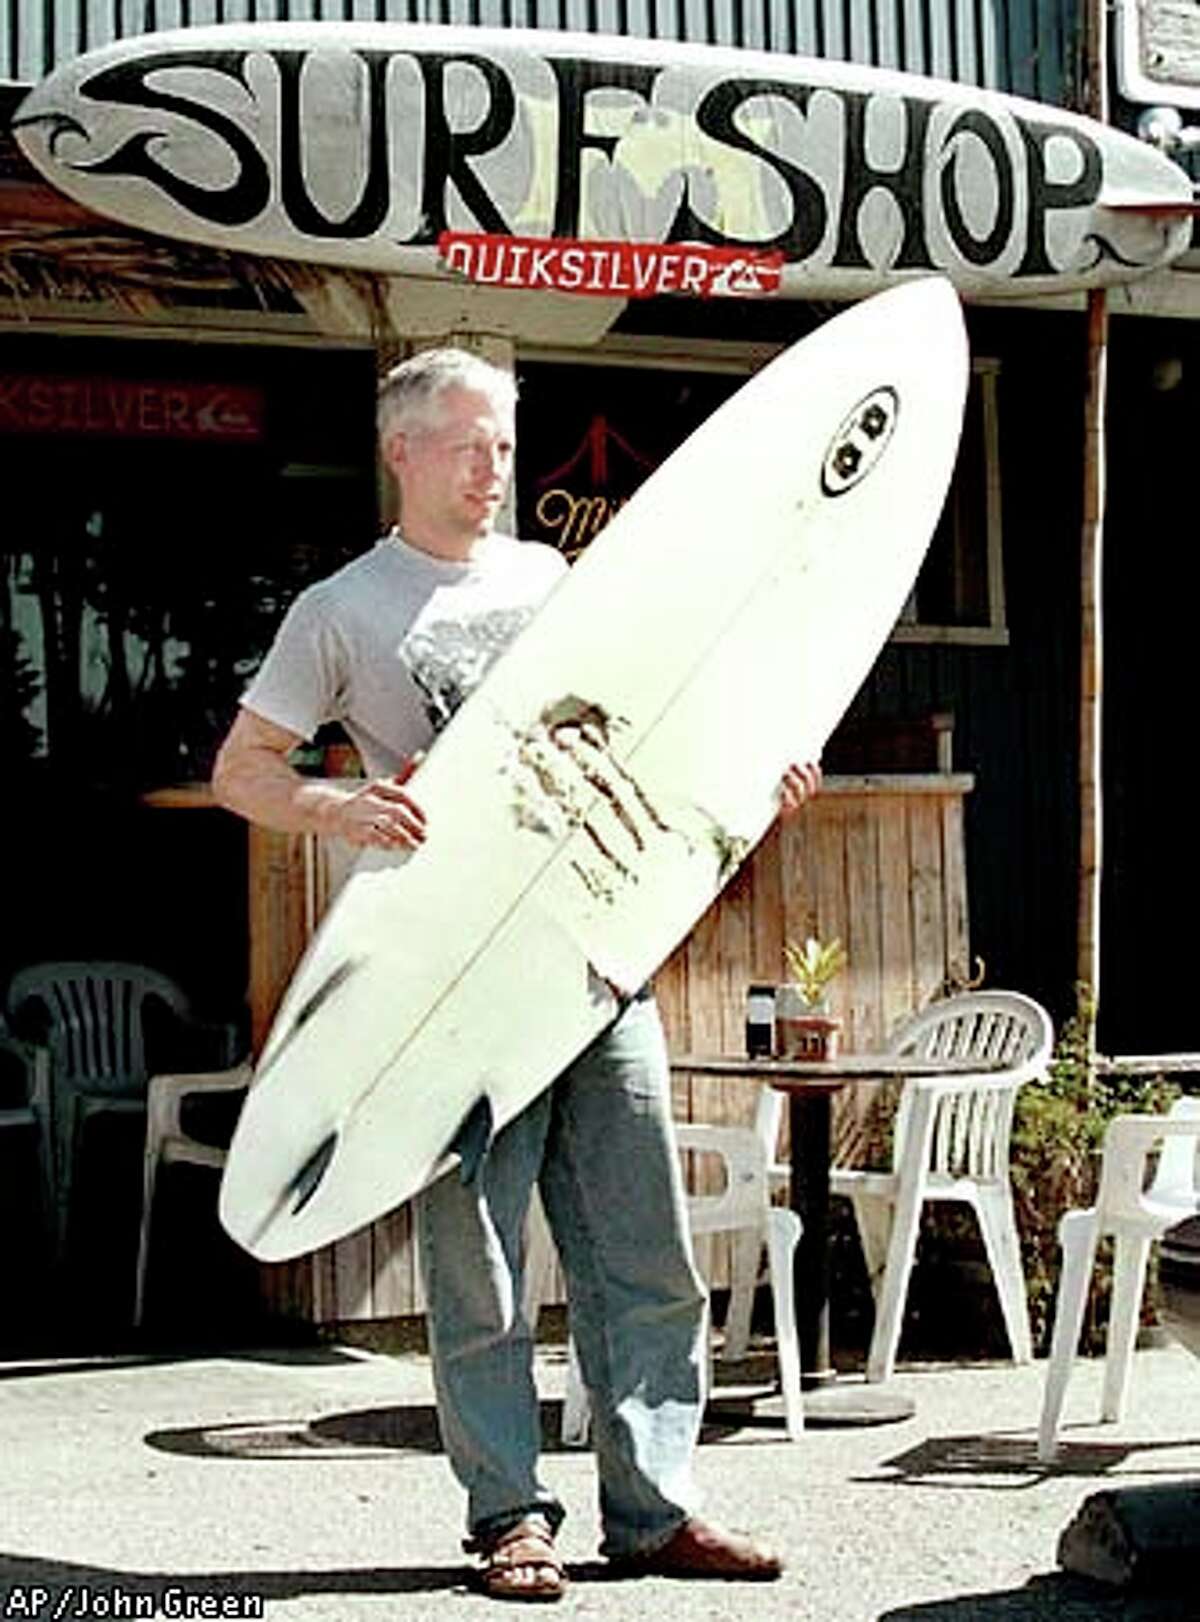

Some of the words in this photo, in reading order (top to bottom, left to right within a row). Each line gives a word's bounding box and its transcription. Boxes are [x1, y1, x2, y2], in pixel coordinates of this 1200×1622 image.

[72, 50, 664, 244] SURF
[663, 78, 1103, 275] SHOP
[447, 241, 704, 294] QUIKSILVER
